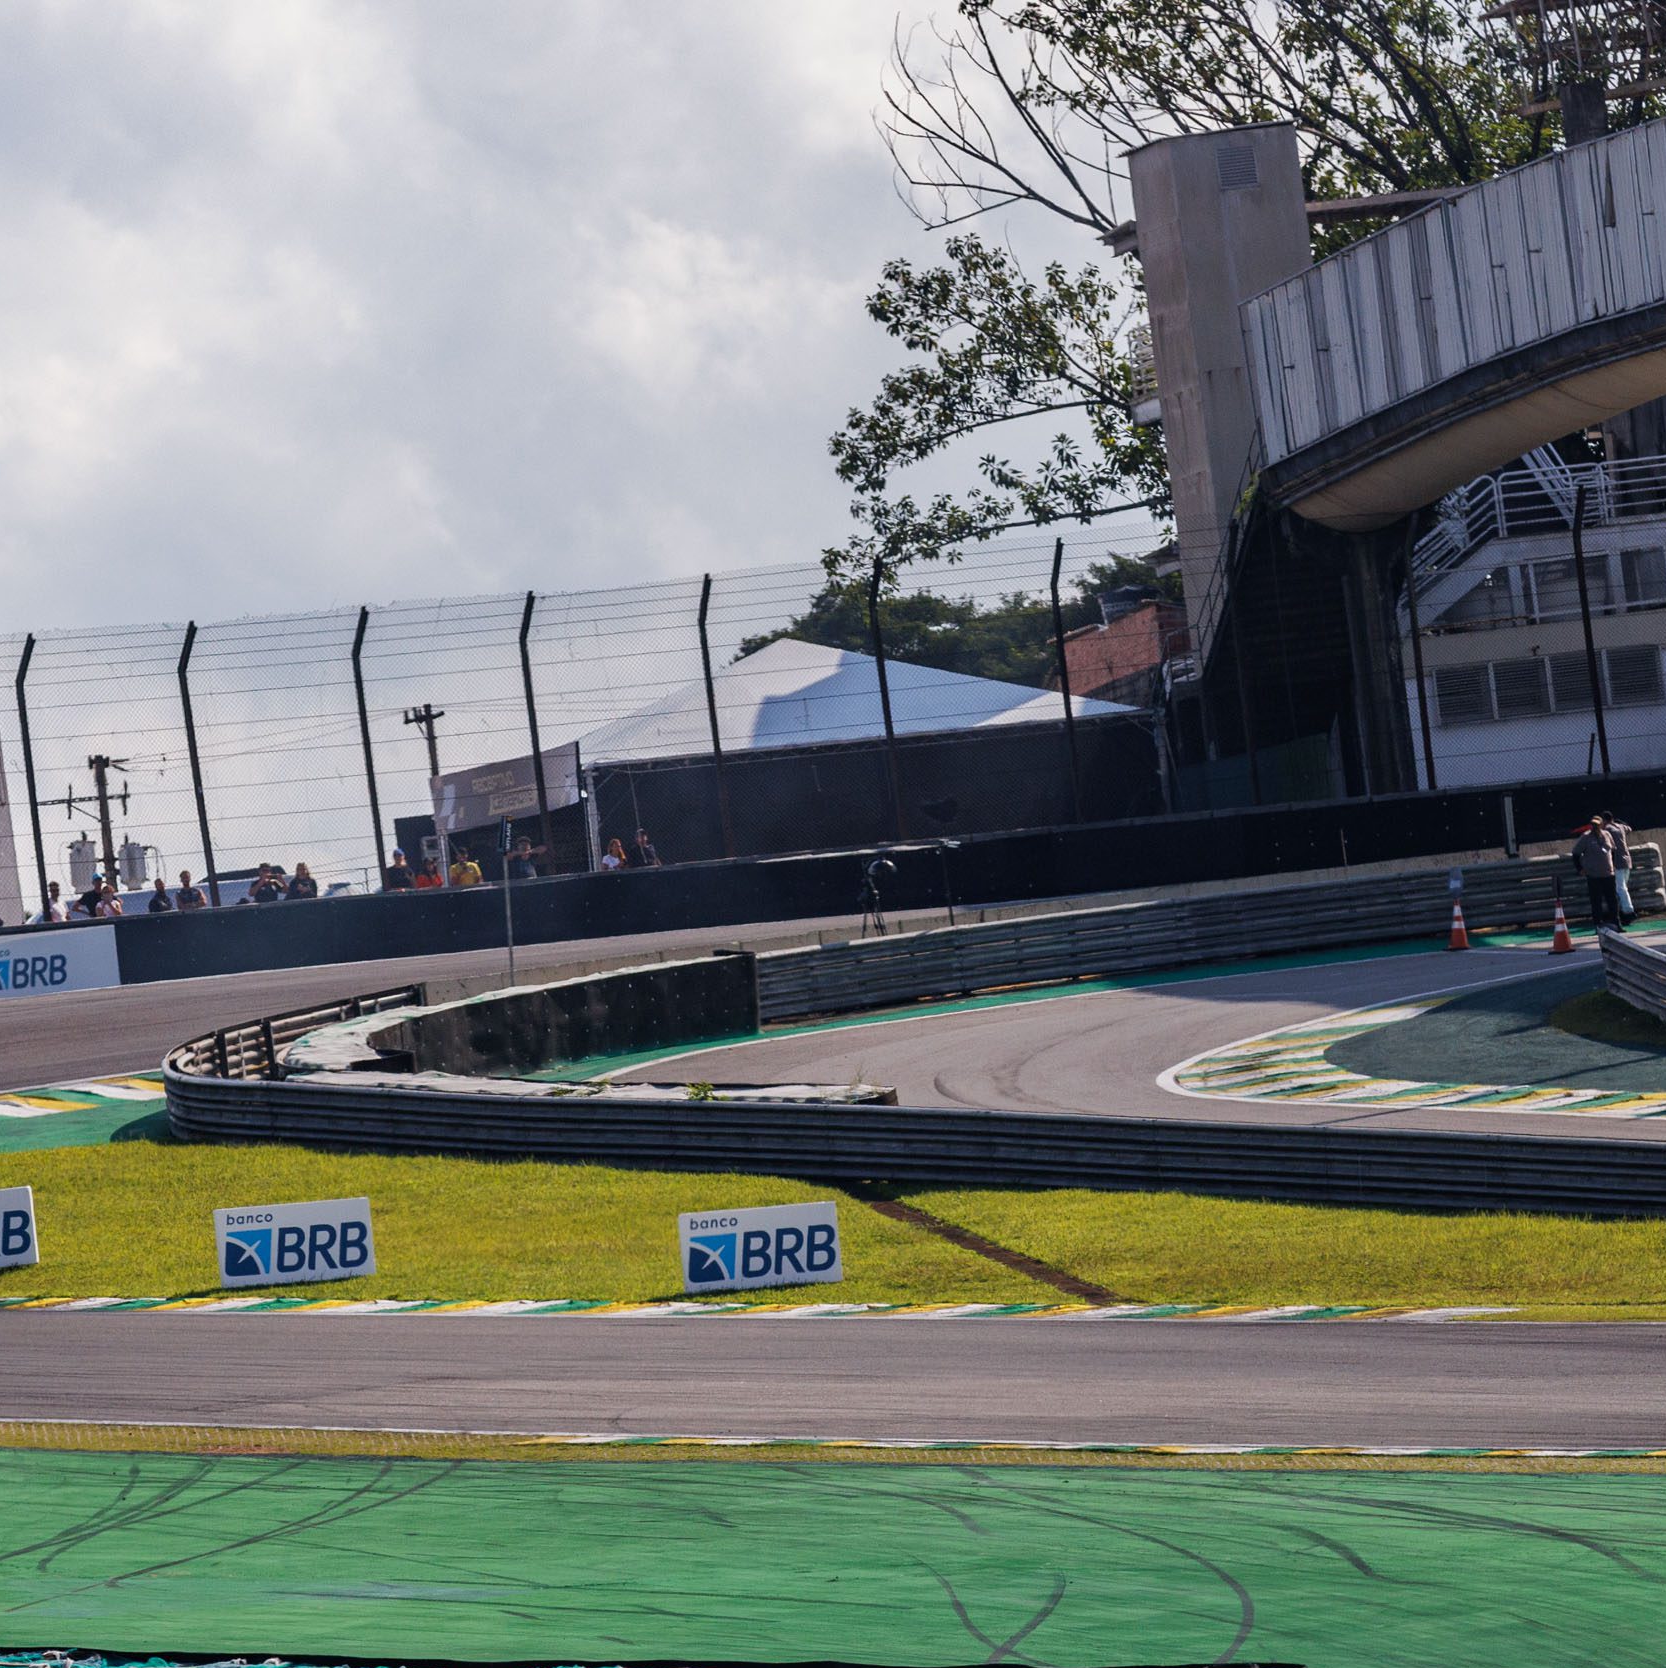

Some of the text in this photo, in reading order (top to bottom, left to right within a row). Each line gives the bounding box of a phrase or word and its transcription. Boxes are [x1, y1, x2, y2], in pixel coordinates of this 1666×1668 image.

[12, 954, 67, 989] BRB
[226, 1211, 274, 1226] banco
[689, 1216, 739, 1231] banco
[277, 1221, 369, 1274] BRB
[742, 1223, 836, 1280] BRB
